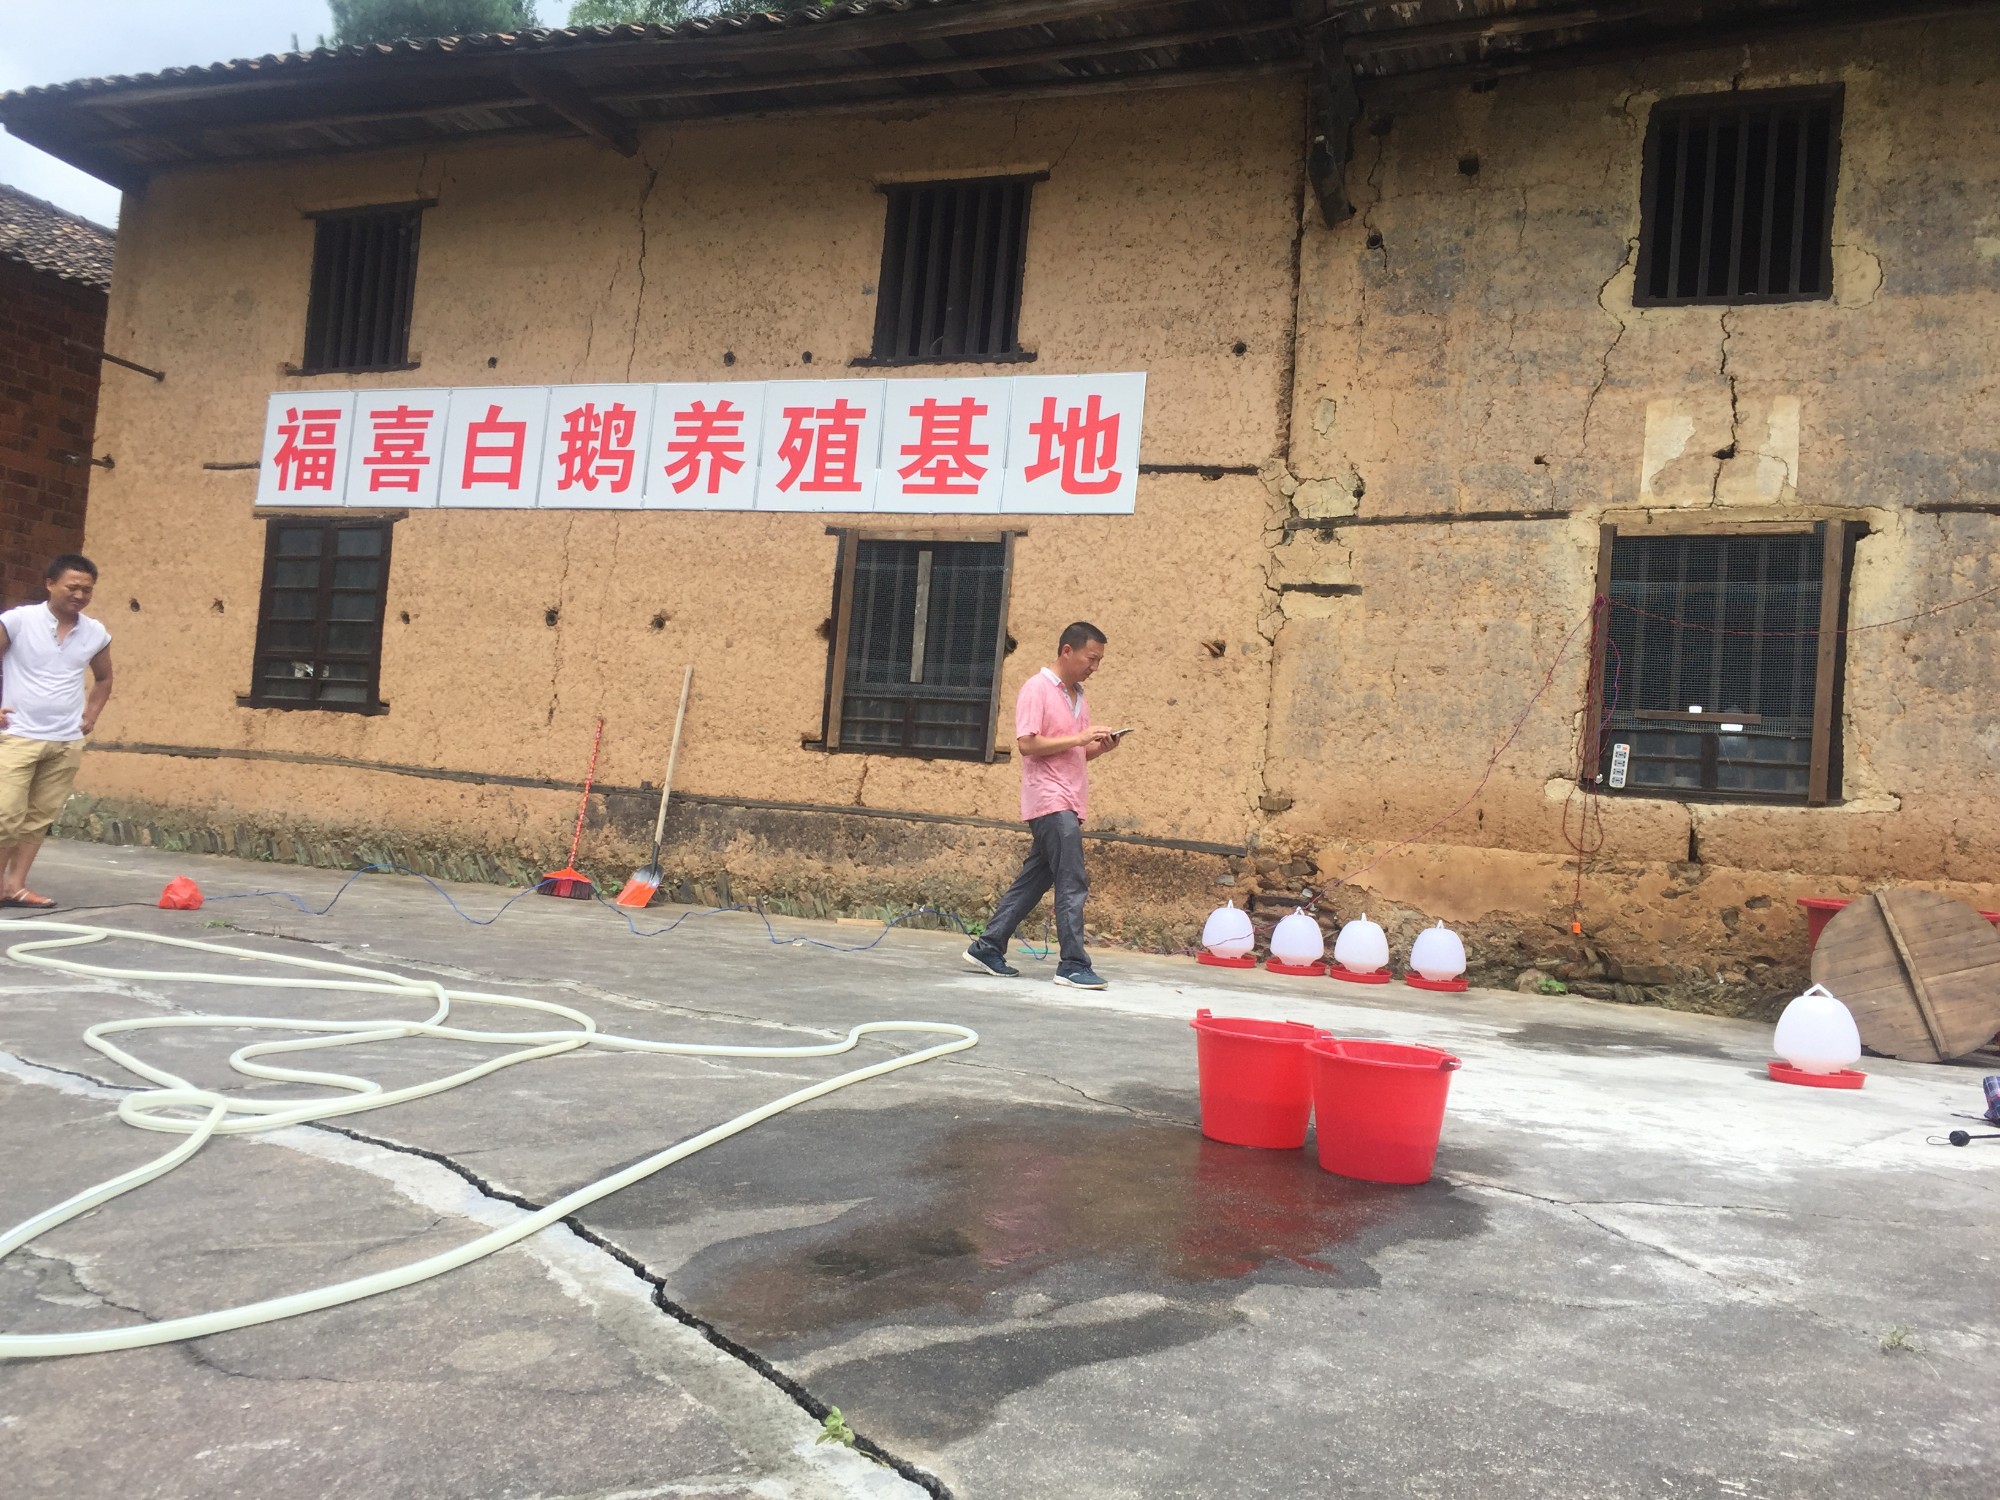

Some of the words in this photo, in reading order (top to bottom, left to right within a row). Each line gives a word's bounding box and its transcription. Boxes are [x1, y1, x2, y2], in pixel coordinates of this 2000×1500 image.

[273, 394, 1122, 495] 福喜白鹅养殖基地
